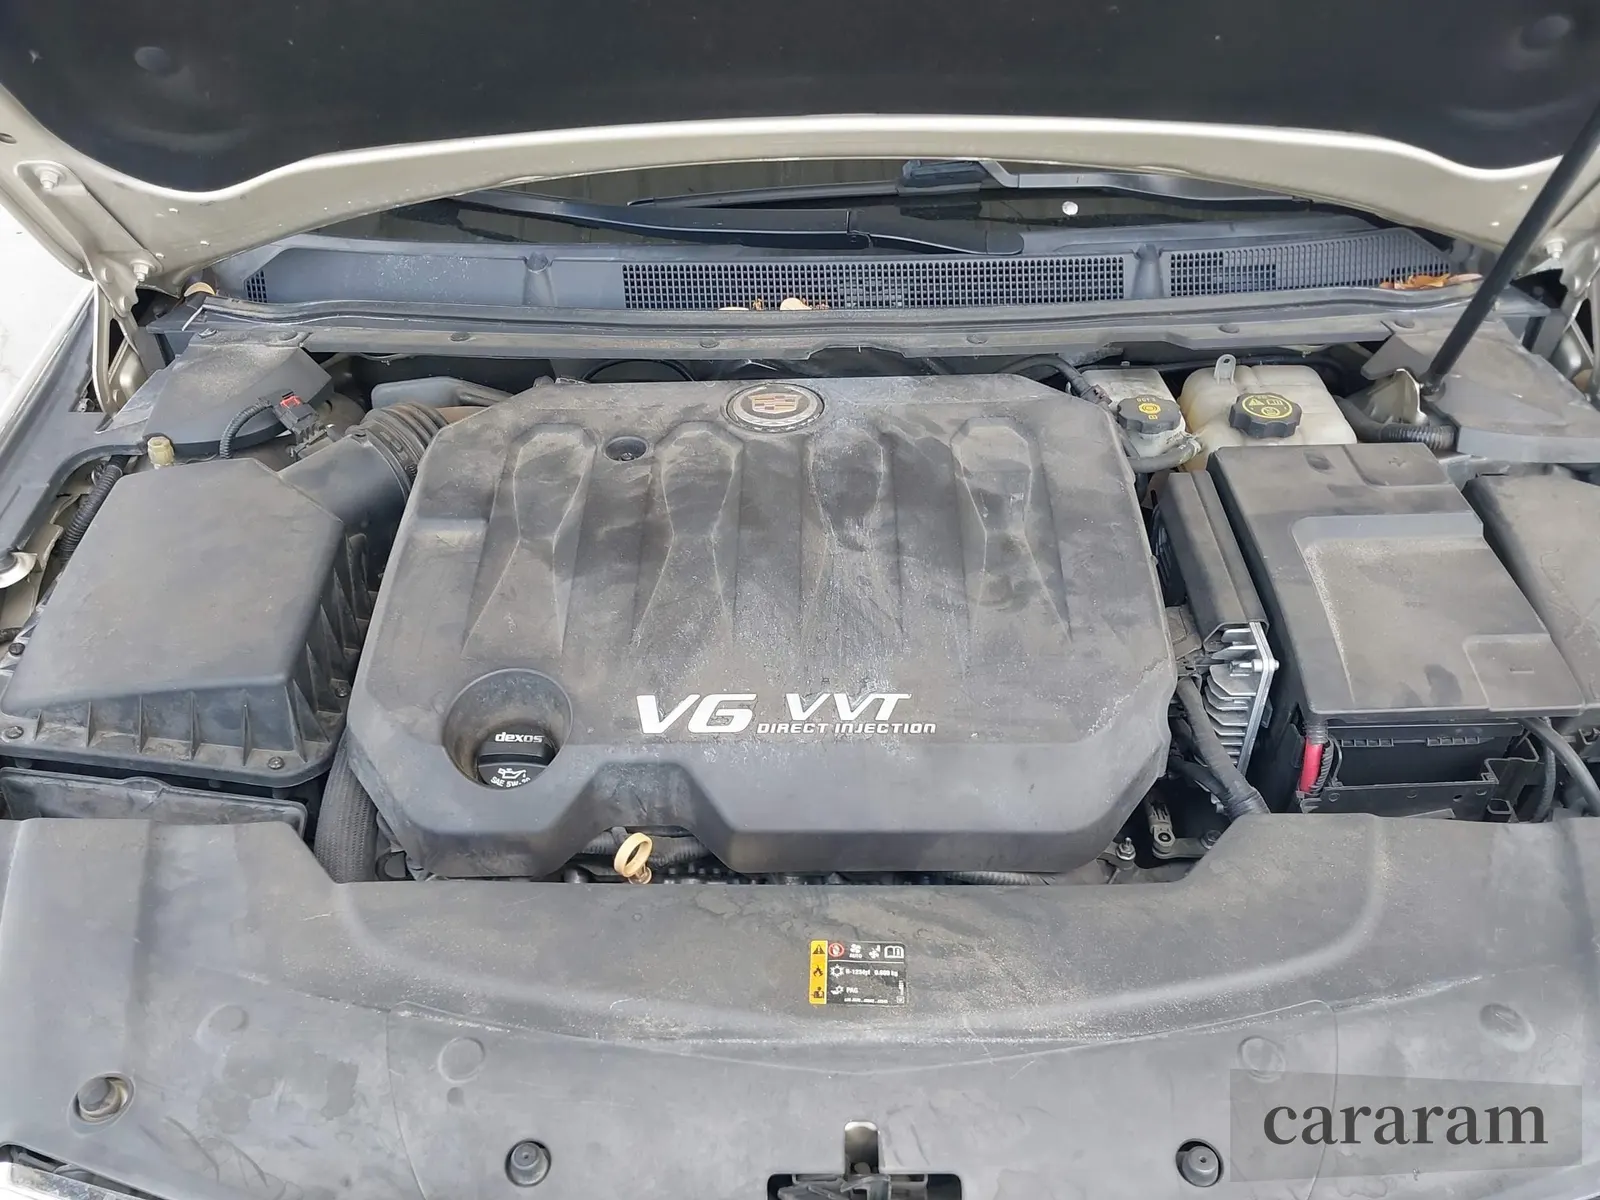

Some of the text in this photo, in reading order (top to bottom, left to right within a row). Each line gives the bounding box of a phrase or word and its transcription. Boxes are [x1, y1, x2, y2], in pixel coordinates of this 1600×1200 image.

[784, 693, 912, 721] VVT
[636, 693, 757, 734] V6
[756, 723, 937, 735] DIRECT INJECTION
[495, 732, 545, 743] dexos
[490, 776, 505, 787] SAE
[891, 969, 899, 978] kg
[846, 986, 859, 994] PAG
